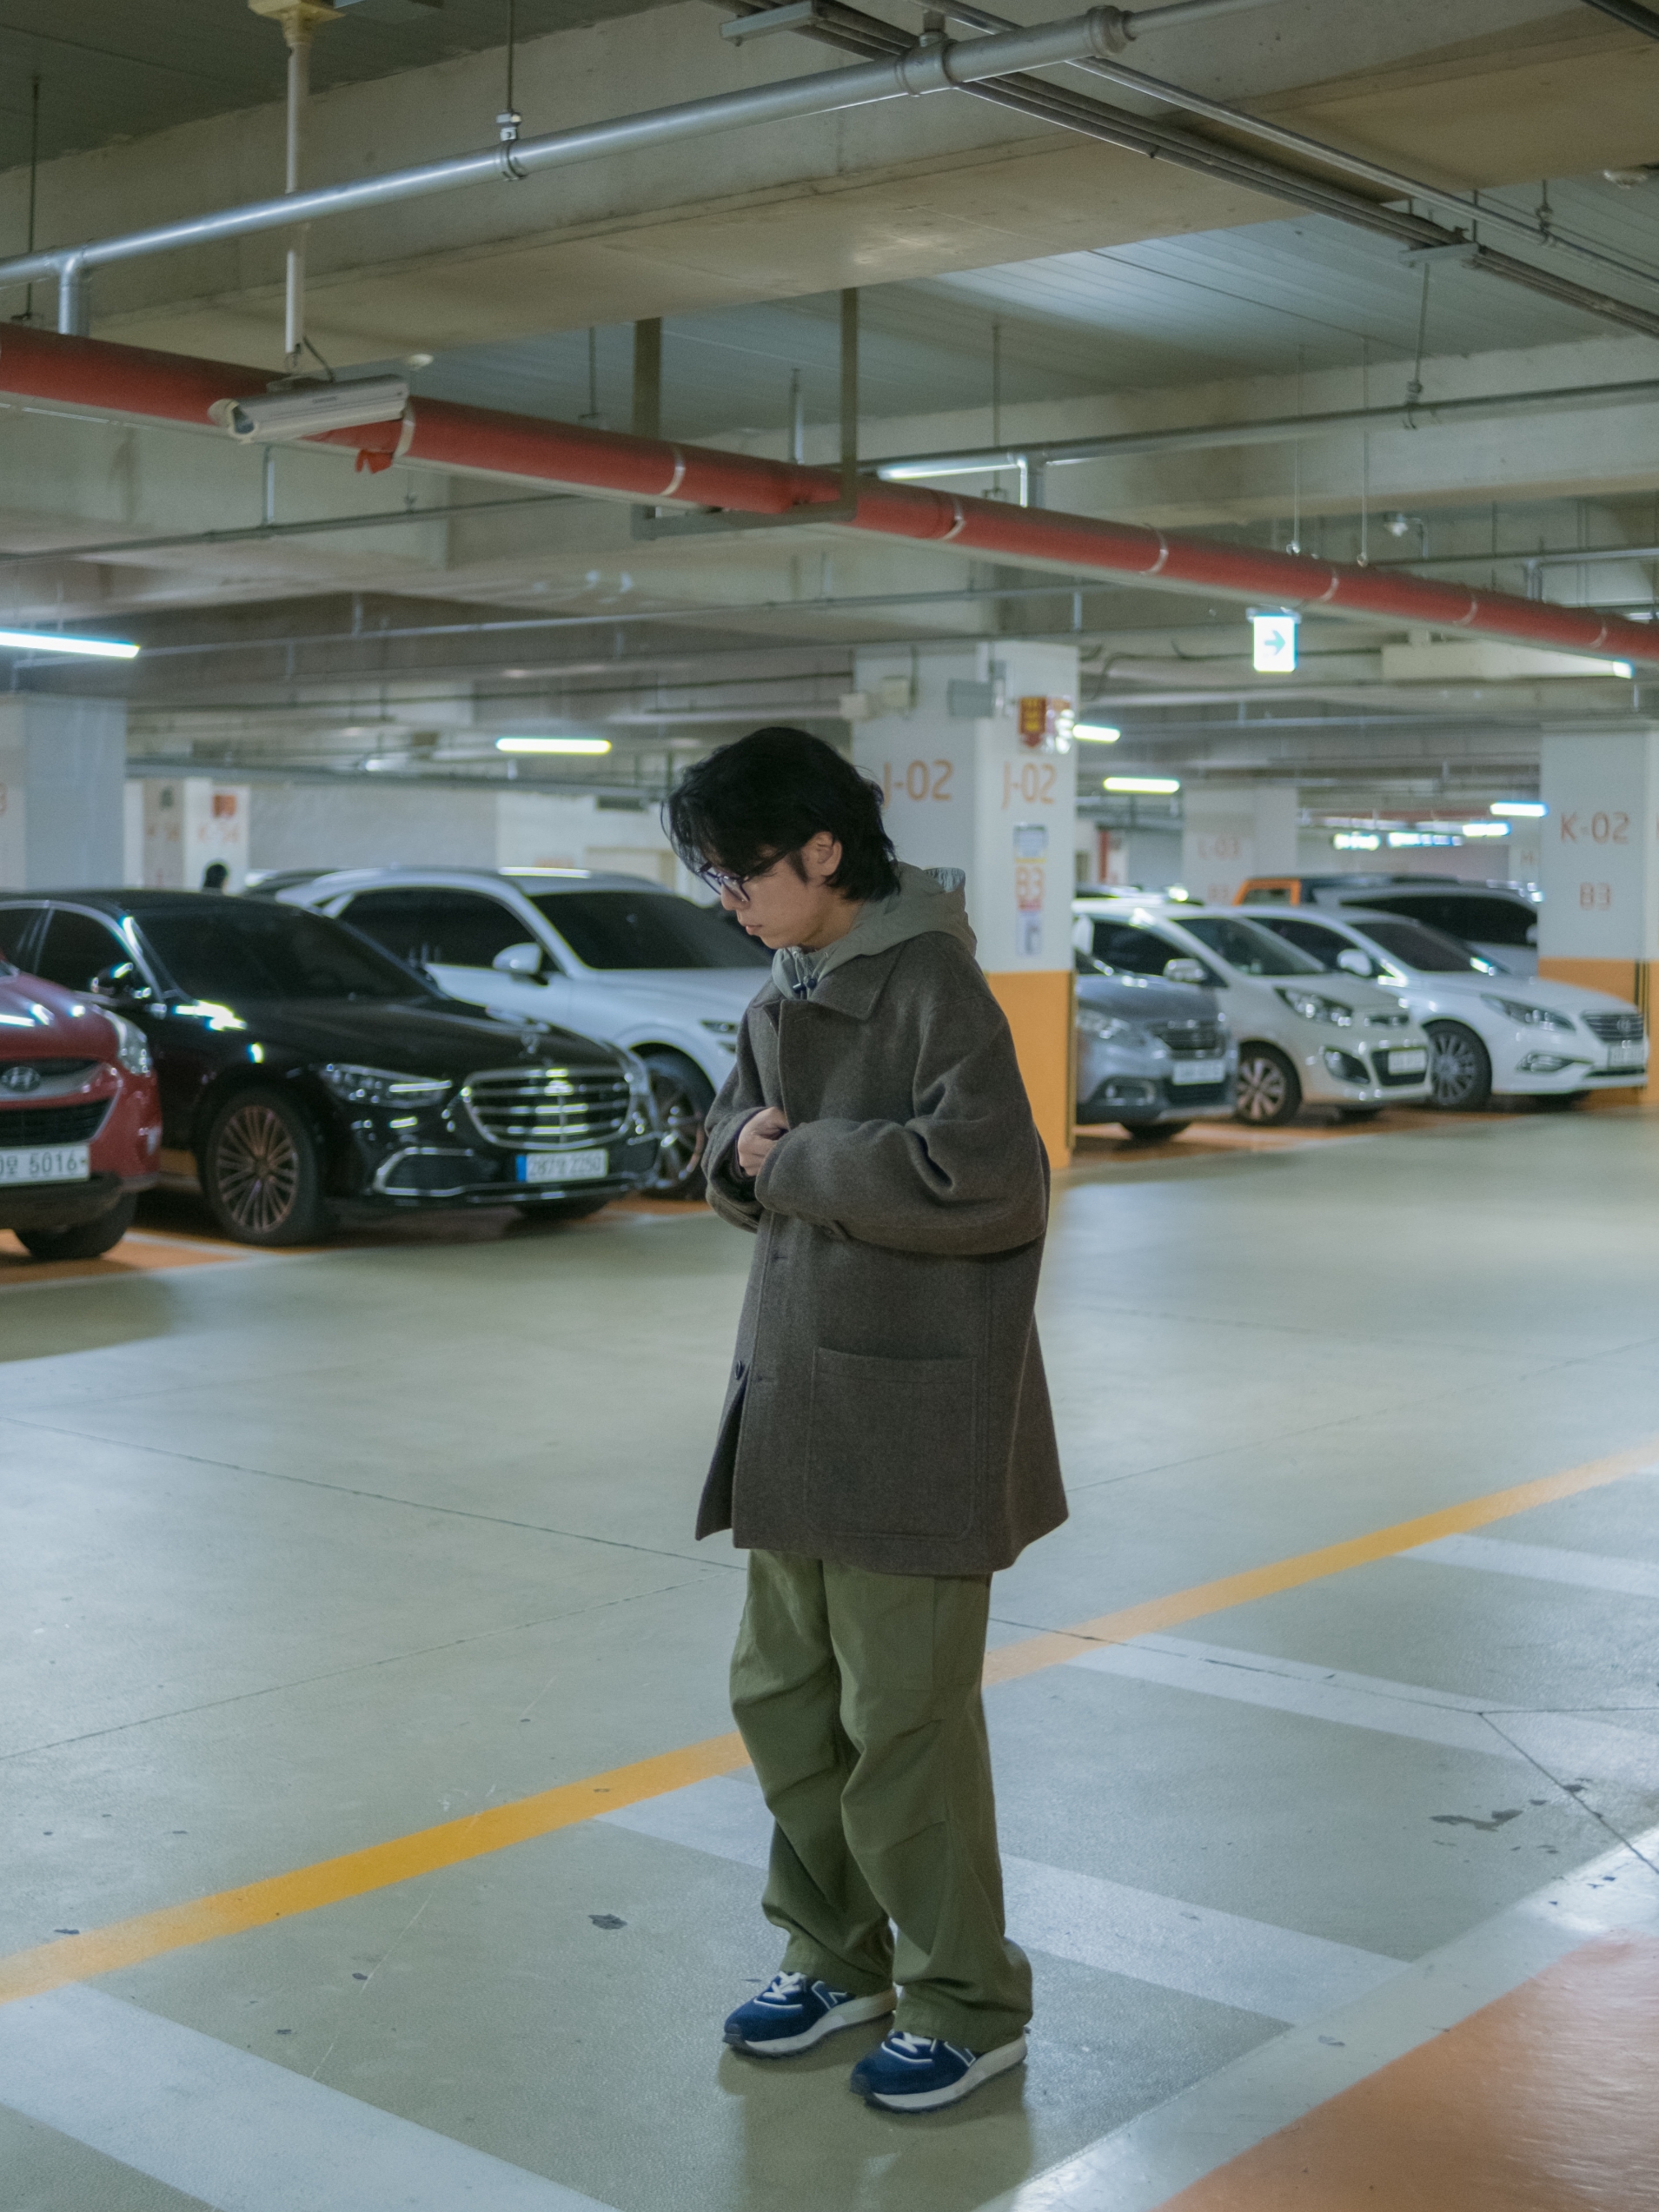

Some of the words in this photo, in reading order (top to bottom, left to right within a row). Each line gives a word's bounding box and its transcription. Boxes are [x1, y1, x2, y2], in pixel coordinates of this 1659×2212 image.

[882, 759, 953, 810] J-02
[1001, 761, 1057, 811] J-02
[1560, 811, 1630, 844] K-02
[1579, 882, 1612, 911] B3
[30, 1150, 77, 1175] 5016
